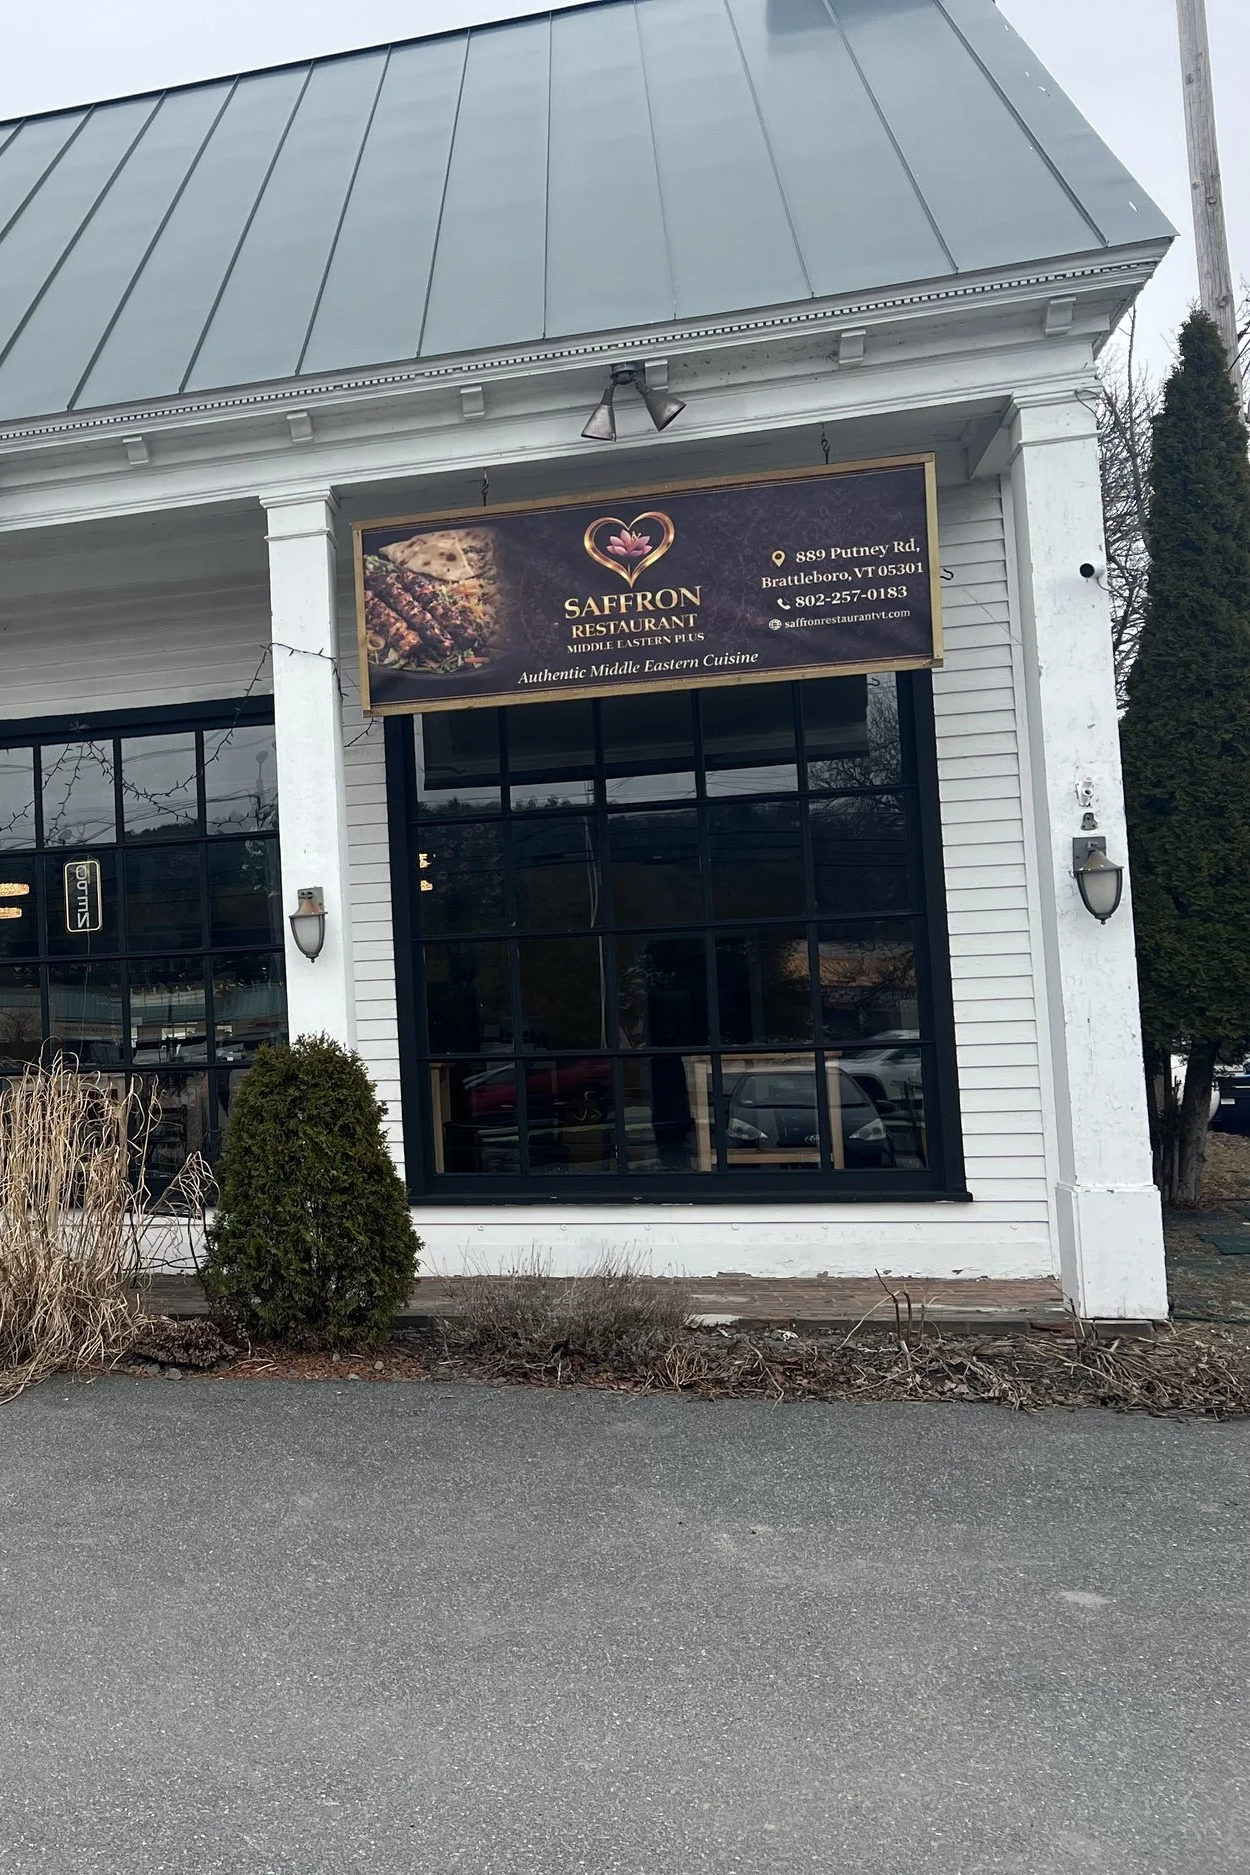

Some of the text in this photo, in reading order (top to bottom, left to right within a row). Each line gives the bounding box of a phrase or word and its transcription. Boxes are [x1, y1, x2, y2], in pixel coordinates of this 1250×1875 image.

[795, 538, 921, 563] 889 Putney Rd,
[761, 562, 924, 589] Brattleboro, VT 05301
[564, 586, 702, 620] SAFFRON
[795, 585, 908, 608] 802-257-0183
[571, 613, 698, 639] RESTAURANT
[784, 609, 911, 629] saffronrestaurantvt.com
[567, 632, 705, 654] MIDDLE EASTERN PLUS
[517, 651, 759, 684] Authentic Middle Eastern Cuisine
